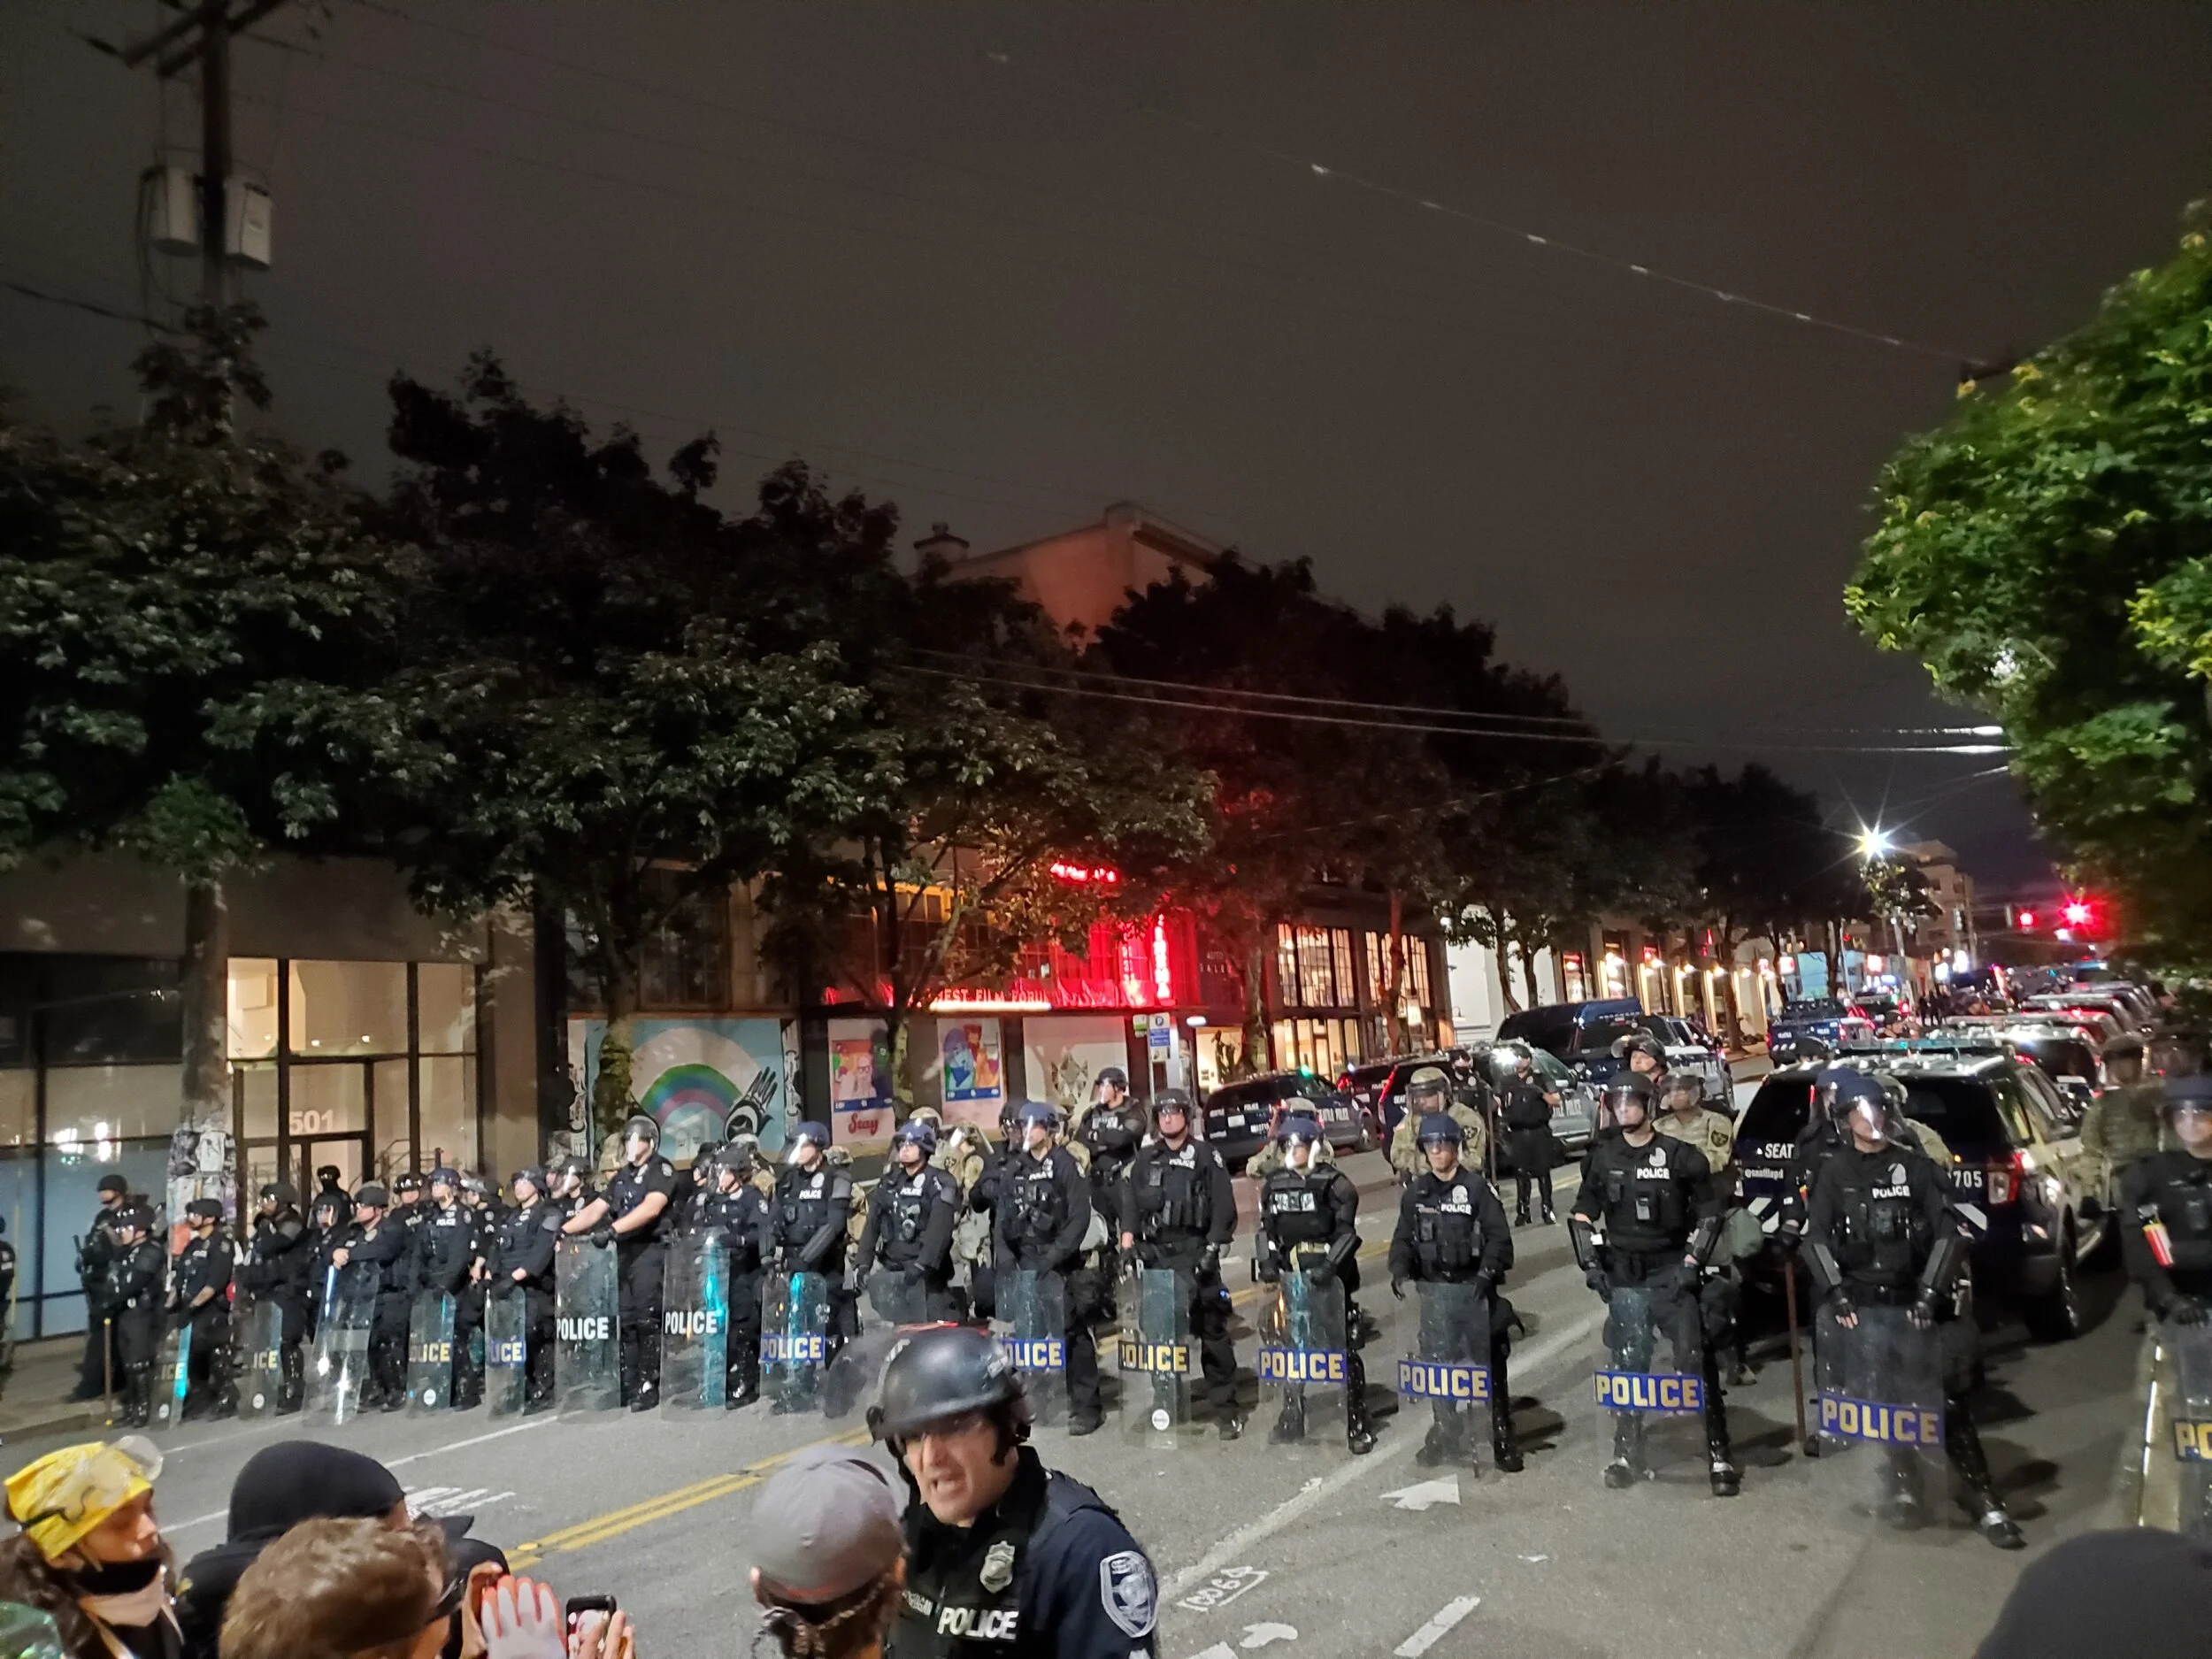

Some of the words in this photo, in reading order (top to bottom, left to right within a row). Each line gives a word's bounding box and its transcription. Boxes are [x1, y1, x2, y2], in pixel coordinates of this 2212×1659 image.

[289, 1109, 334, 1136] 501
[849, 1112, 879, 1135] Stay
[1764, 1142, 1795, 1159] SEAT
[1169, 1157, 1195, 1170] POLICE
[1636, 1167, 1671, 1180] POLICE
[1948, 1170, 1983, 1188] 705
[798, 1189, 822, 1200] POLICE
[900, 1187, 923, 1196] POLICE
[1871, 1184, 1911, 1199] POLICE
[1440, 1203, 1472, 1216] POLICE
[556, 1317, 609, 1340] POLICE
[664, 1310, 718, 1334] POLICE
[252, 1350, 278, 1369] ICE
[760, 1336, 822, 1361] POLICE
[1005, 1340, 1063, 1367] OLICE
[161, 1363, 184, 1379] ICE
[1260, 1350, 1344, 1379] POLICE
[1400, 1363, 1488, 1398] POLICE
[1595, 1374, 1701, 1407] POLICE
[1822, 1398, 1940, 1444] POLICE
[936, 1606, 1020, 1640] POLICE
